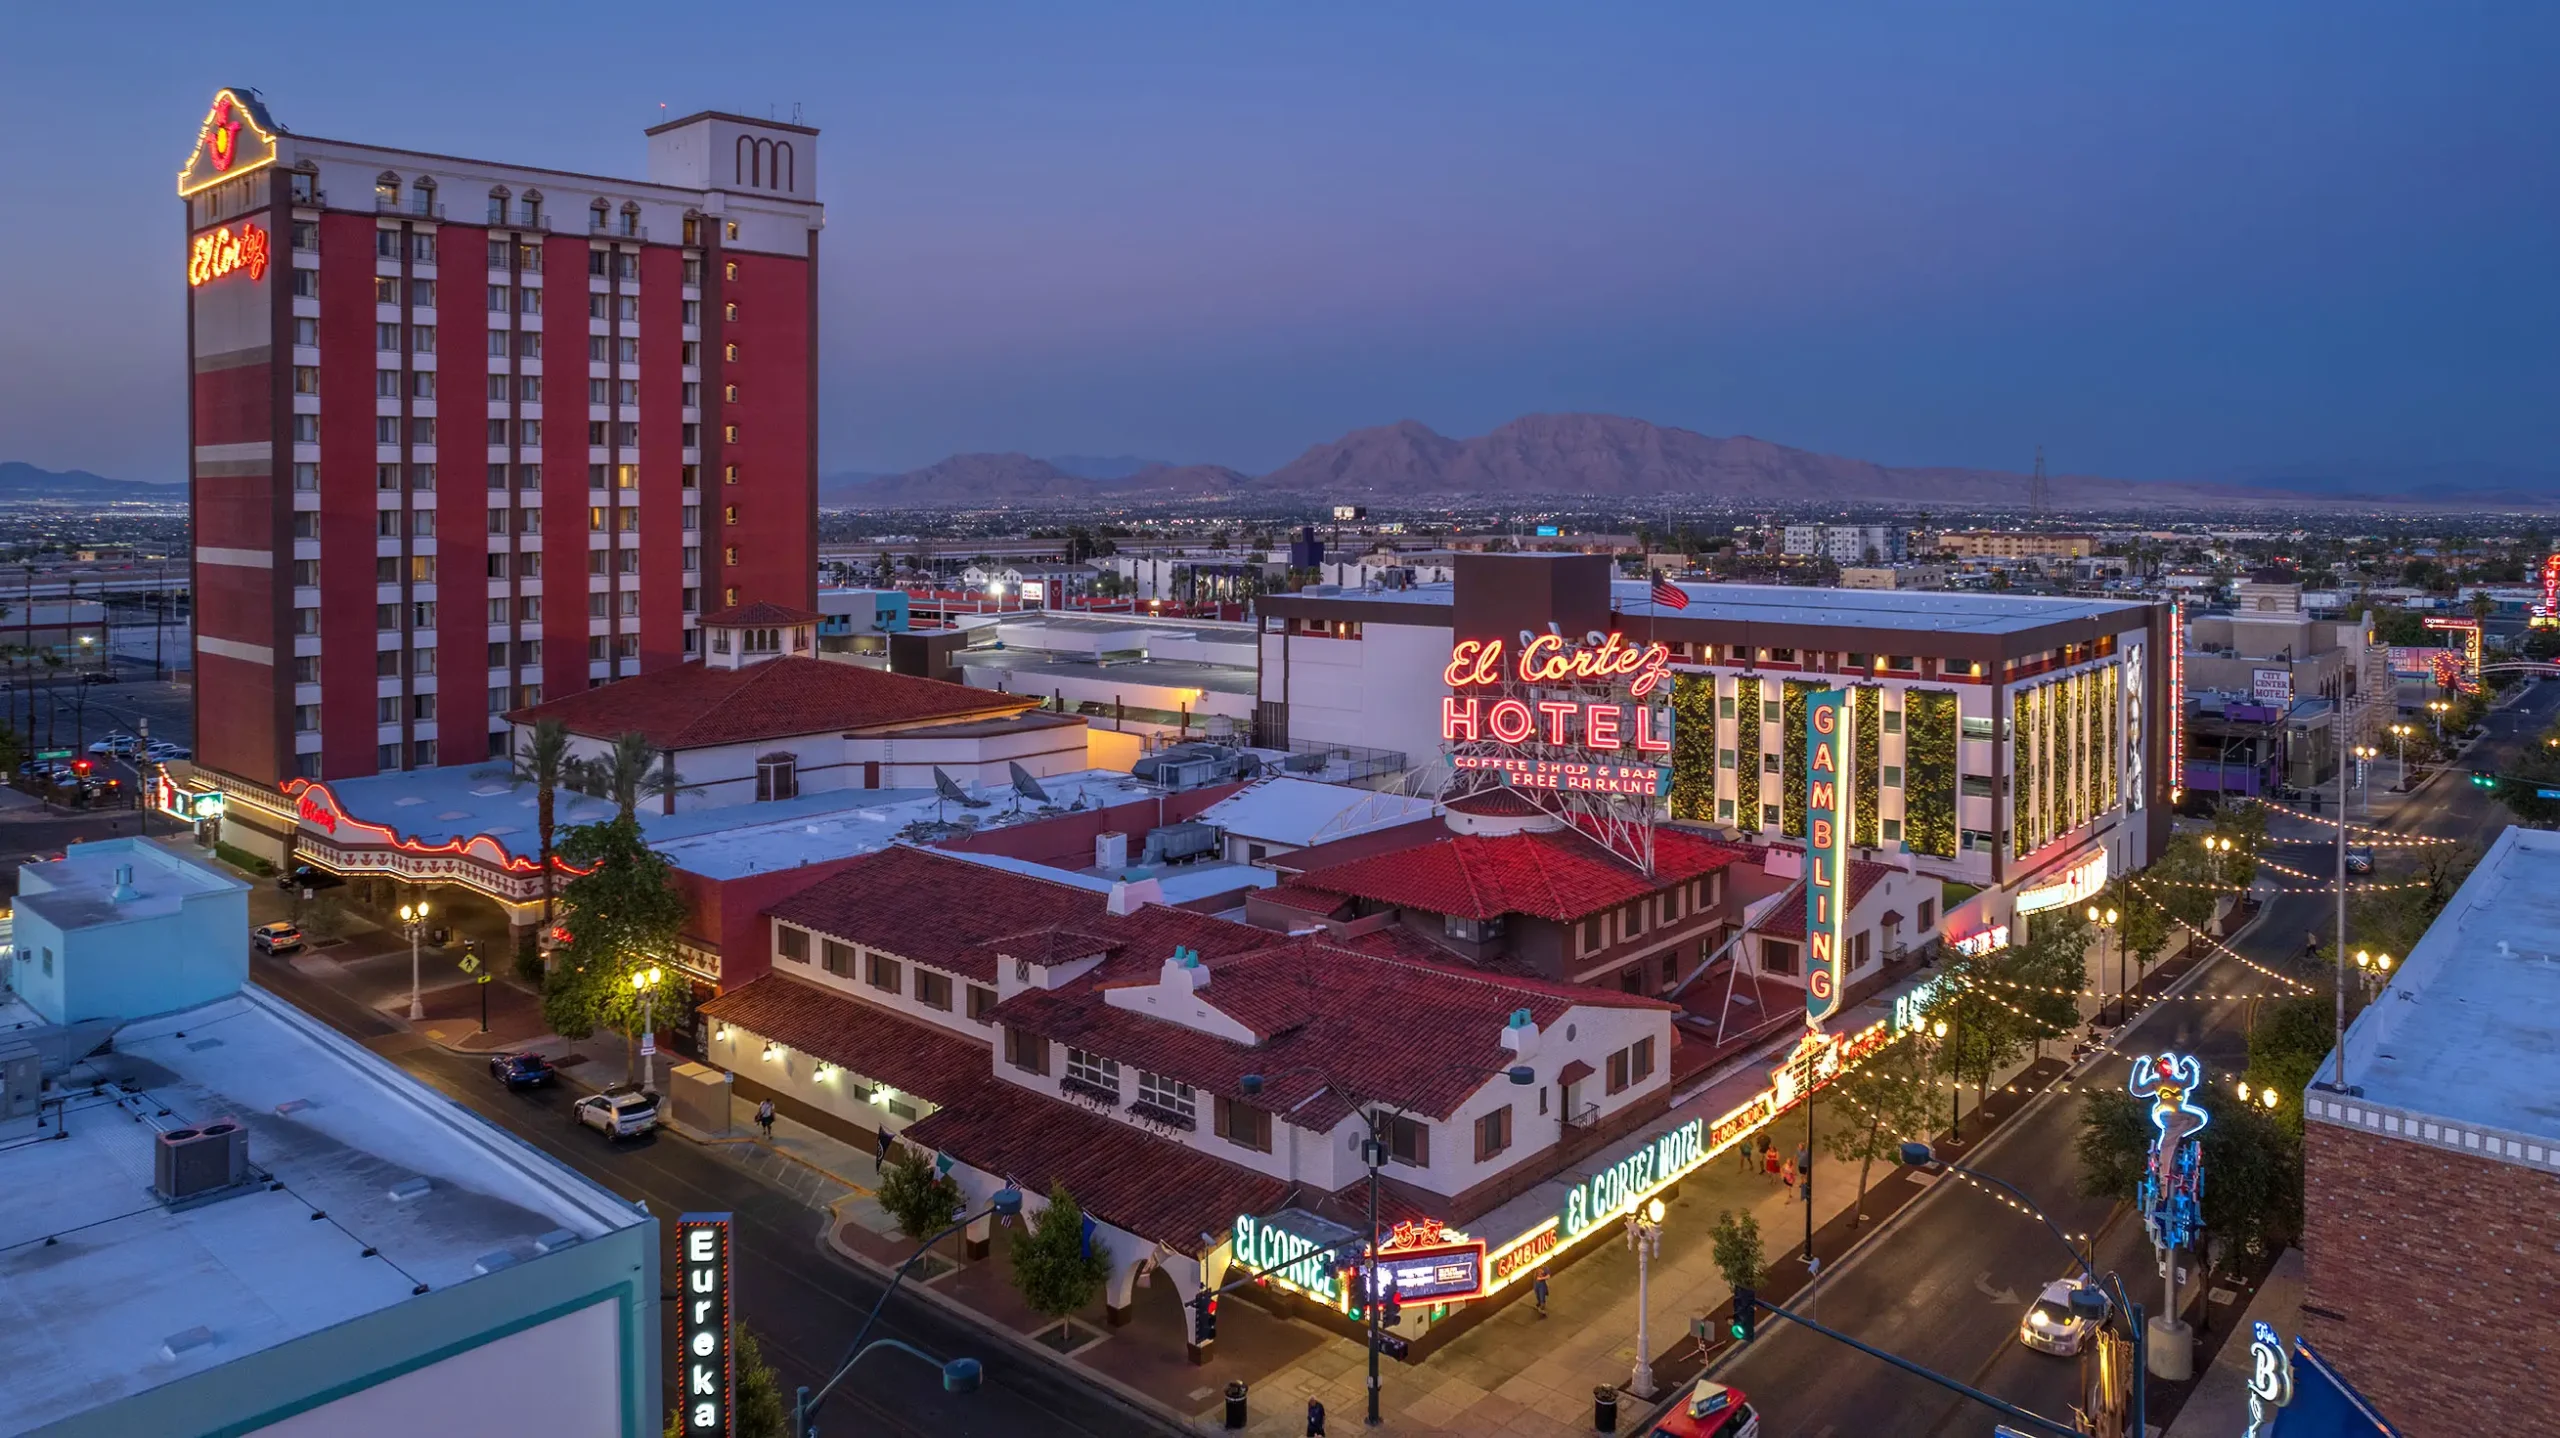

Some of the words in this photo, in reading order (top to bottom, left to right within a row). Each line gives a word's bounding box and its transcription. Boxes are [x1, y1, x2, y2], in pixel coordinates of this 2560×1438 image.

[188, 234, 214, 287] El
[213, 222, 265, 280] Cortez
[2546, 570, 2557, 616] MOTEL
[1444, 640, 1502, 687] El
[1519, 631, 1672, 697] Cortez
[2255, 680, 2288, 689] CENTER
[2262, 672, 2281, 680] CITY
[2255, 688, 2288, 698] MOTEL
[1443, 697, 1671, 751] HOTEL
[1454, 757, 1529, 772] COFFEE
[1538, 762, 1590, 775] SHOP
[1597, 765, 1611, 776] &
[1620, 768, 1659, 781] BAR
[1511, 772, 1559, 789] FREE
[1567, 778, 1657, 796] PARKING
[1809, 704, 1837, 1000] GAMBLING
[1567, 1184, 1590, 1235] EL
[1592, 1144, 1655, 1219] CORTEZ
[1658, 1117, 1705, 1181] HOTEL
[1236, 1214, 1259, 1267] EL
[1260, 1225, 1336, 1298] CORTEZ
[1497, 1228, 1558, 1278] GAMBLING
[690, 1230, 716, 1428] Eureka
[2247, 1341, 2279, 1401] B
